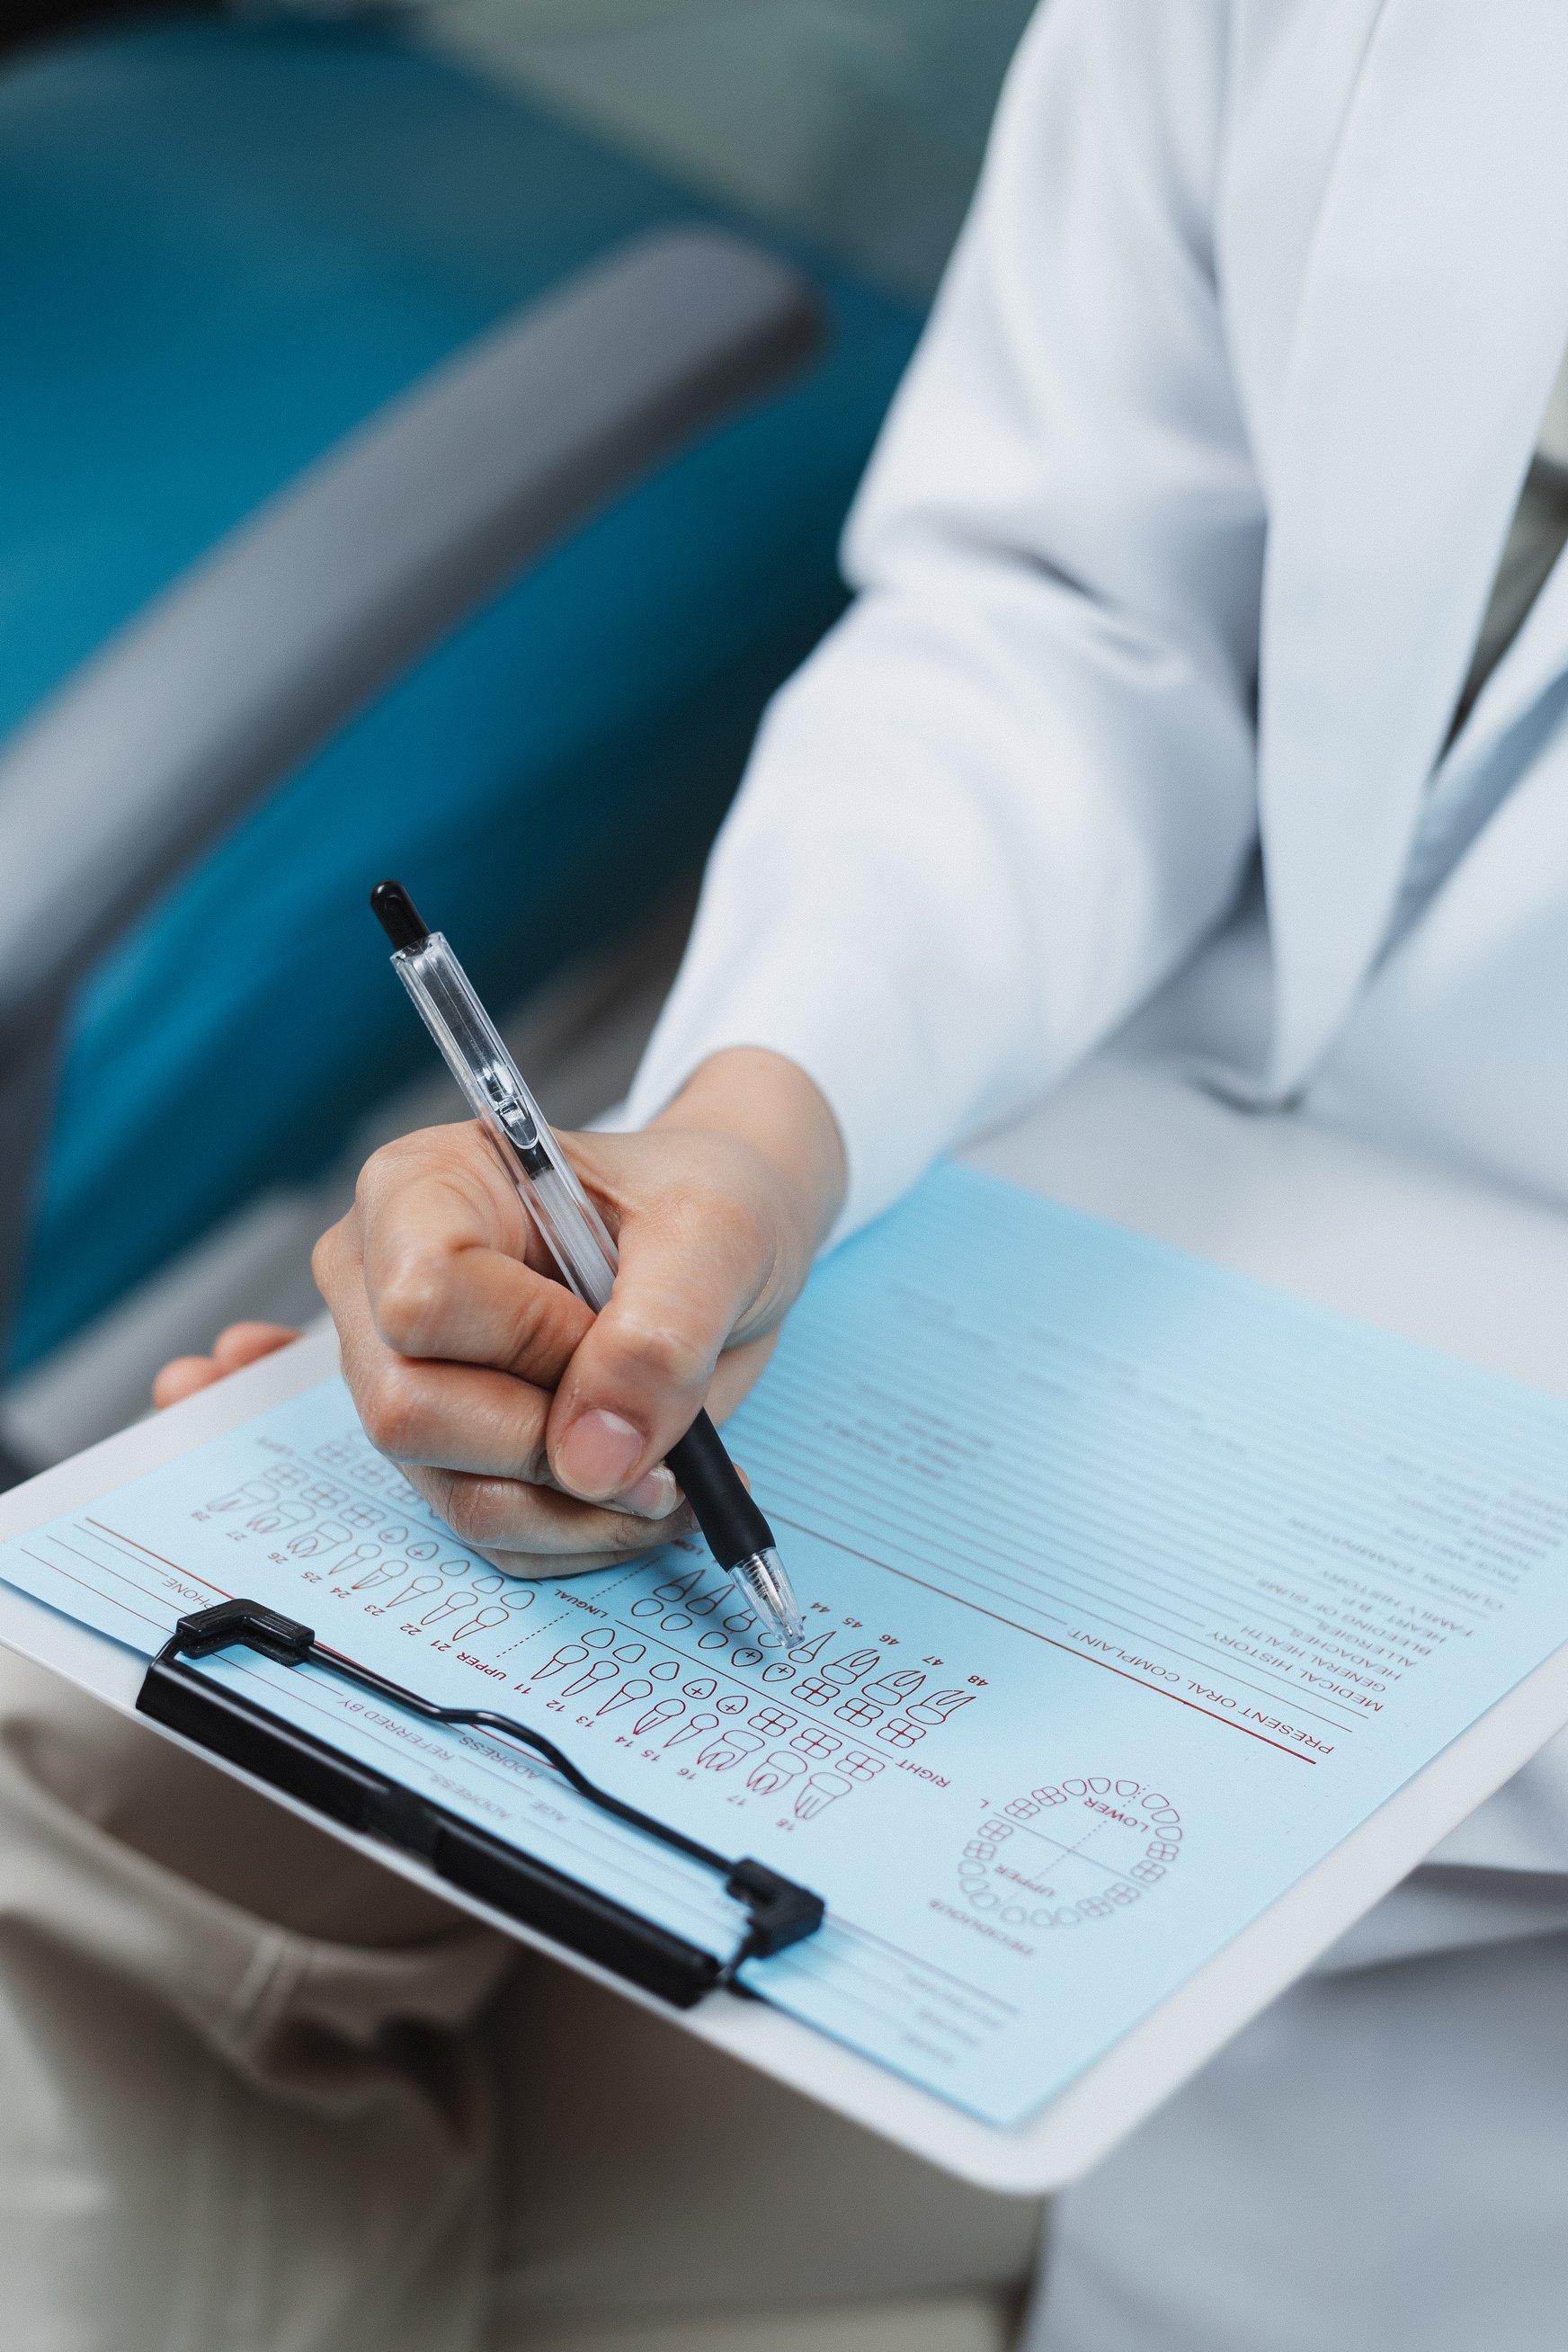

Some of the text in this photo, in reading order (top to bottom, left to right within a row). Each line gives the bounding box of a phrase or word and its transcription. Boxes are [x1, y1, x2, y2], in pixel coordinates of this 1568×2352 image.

[267, 1552, 290, 1564] 26
[300, 1571, 323, 1584] 25
[329, 1586, 352, 1599] 24
[554, 1588, 610, 1619] LINGUAL
[364, 1603, 387, 1617] 23
[1315, 1602, 1340, 1617] OF
[399, 1623, 423, 1636] 22
[1341, 1614, 1433, 1657] BLEEDING
[430, 1639, 452, 1652] 21
[810, 1602, 989, 1688] 48 47 46 45 44
[1289, 1627, 1403, 1681] HEADACHES
[1316, 1619, 1419, 1668] ALLERGIES
[456, 1651, 507, 1680] UPPER
[1204, 1631, 1385, 1713] MEDICAL HISTORY
[1240, 1626, 1387, 1693] GENERAL HEALTH
[513, 1682, 532, 1695] 11
[1187, 1679, 1238, 1709] ORAL
[546, 1699, 566, 1713] 12
[336, 1698, 456, 1763] REFERRED BY
[575, 1715, 594, 1728] 13
[1237, 1706, 1336, 1755] PRESENT
[614, 1735, 634, 1748] 14
[459, 1735, 542, 1781] ADDRESS
[640, 1750, 661, 1762] 15
[676, 1768, 697, 1780] 16
[895, 1759, 951, 1788] RIGHT
[429, 1772, 513, 1821] ADDRESS
[726, 1795, 747, 1806] 17
[531, 1798, 569, 1822] AGE
[1083, 1796, 1149, 1833] LOWER
[776, 1818, 796, 1831] 18
[994, 1863, 1056, 1898] UPPER
